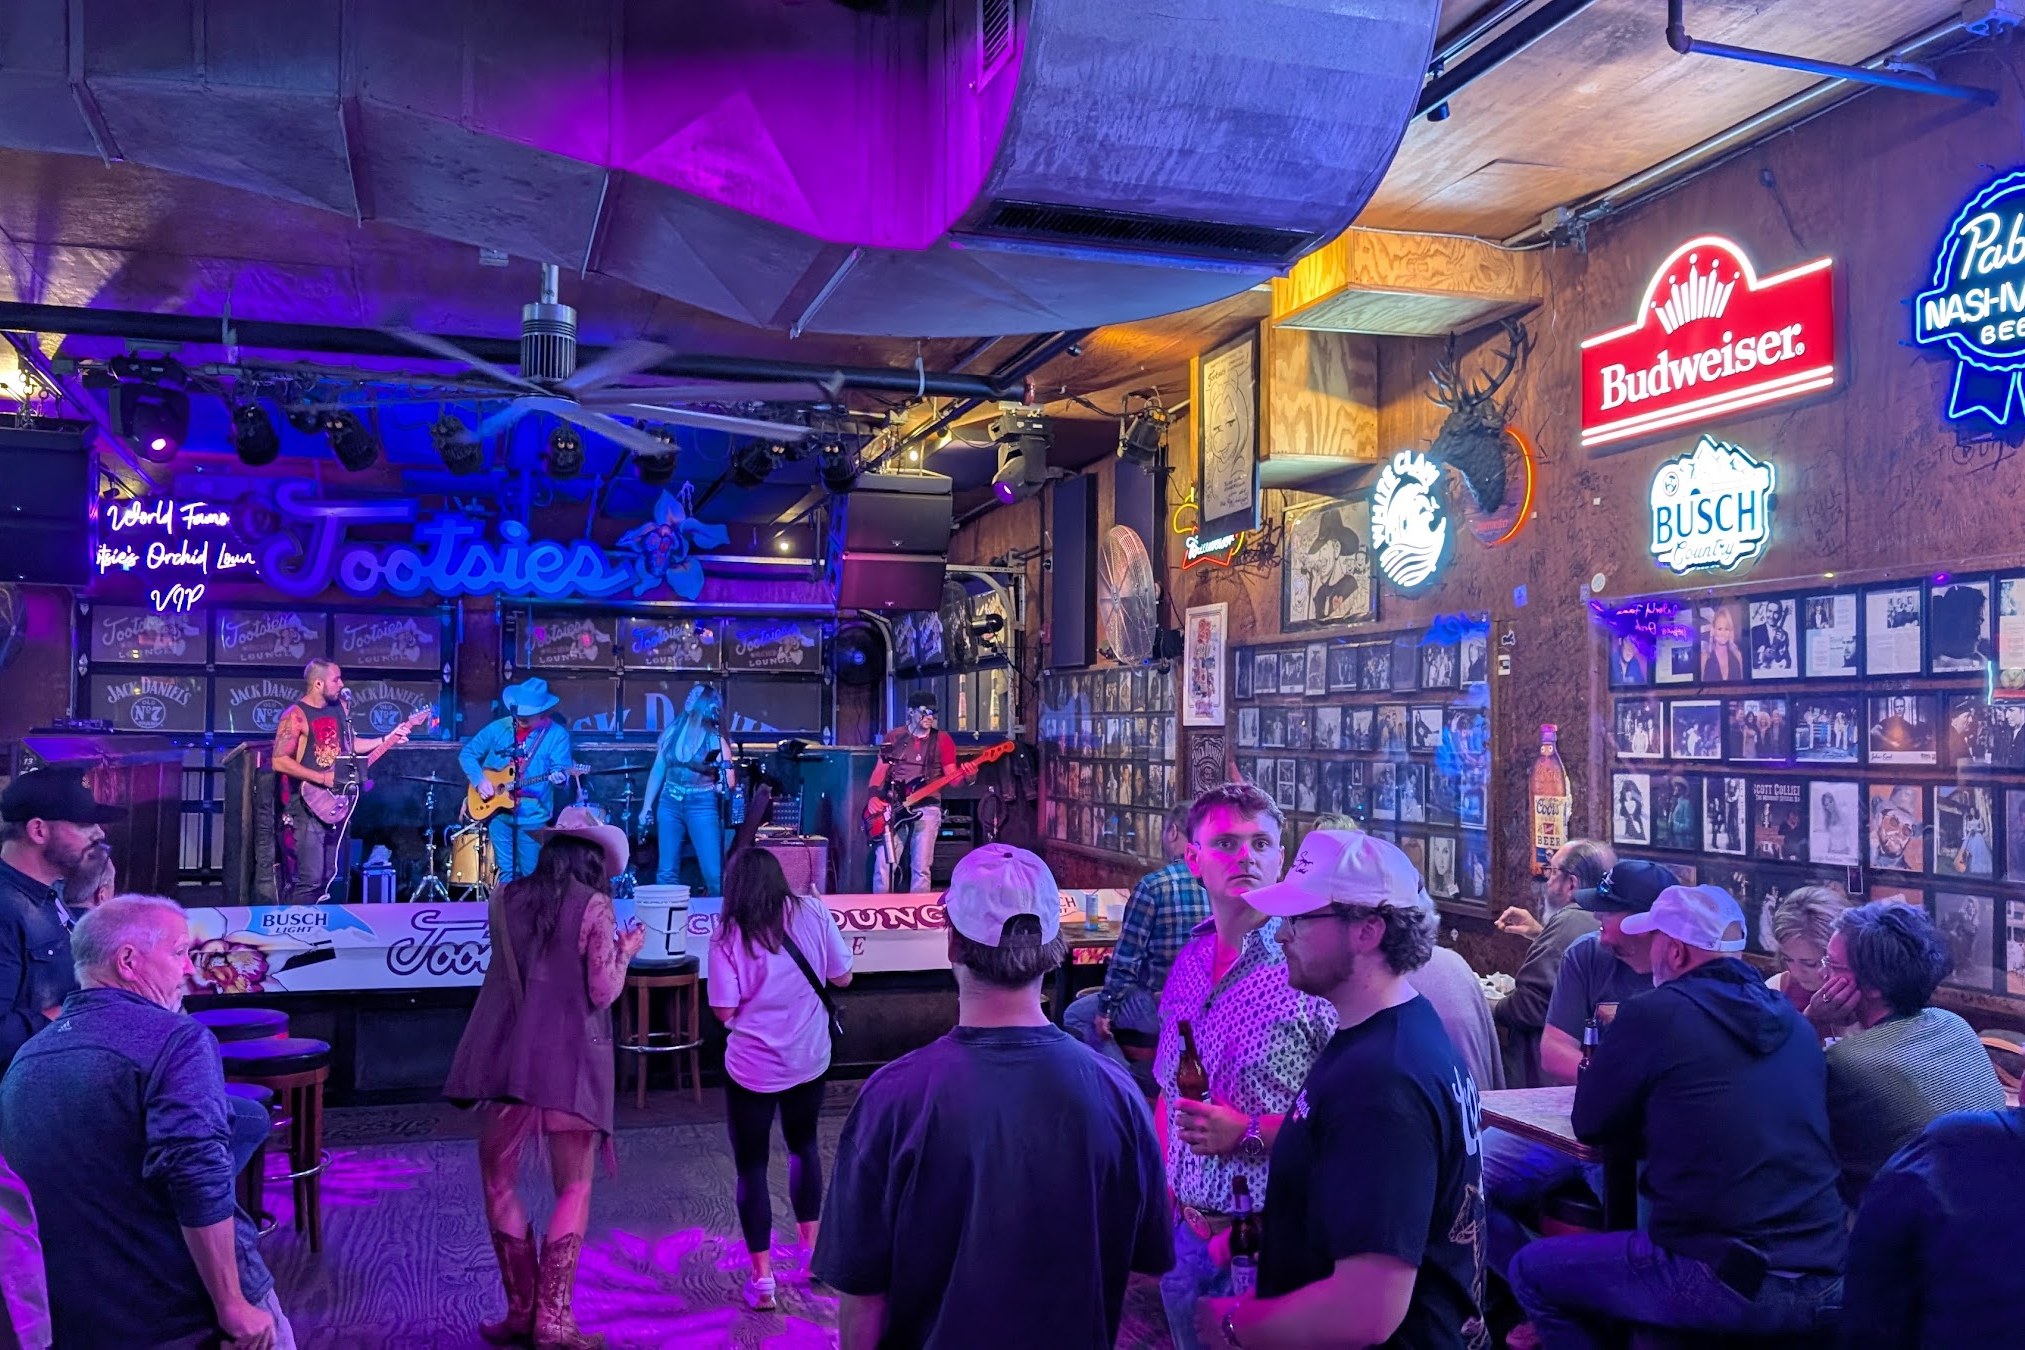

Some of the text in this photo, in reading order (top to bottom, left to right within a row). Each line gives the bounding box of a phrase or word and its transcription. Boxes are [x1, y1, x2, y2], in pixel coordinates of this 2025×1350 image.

[1600, 323, 1803, 410] Budweiser
[1393, 450, 1441, 488] CLAW
[107, 500, 174, 535] World
[1657, 490, 1755, 545] BUSCH
[262, 478, 630, 592] Tootsies
[146, 539, 208, 575] Orchid
[150, 583, 205, 613] VIP
[229, 684, 261, 706] JACK
[1537, 799, 1559, 815] Coors
[1537, 835, 1561, 848] BEER
[262, 913, 328, 928] BUSCH
[275, 926, 313, 935] LIGHT
